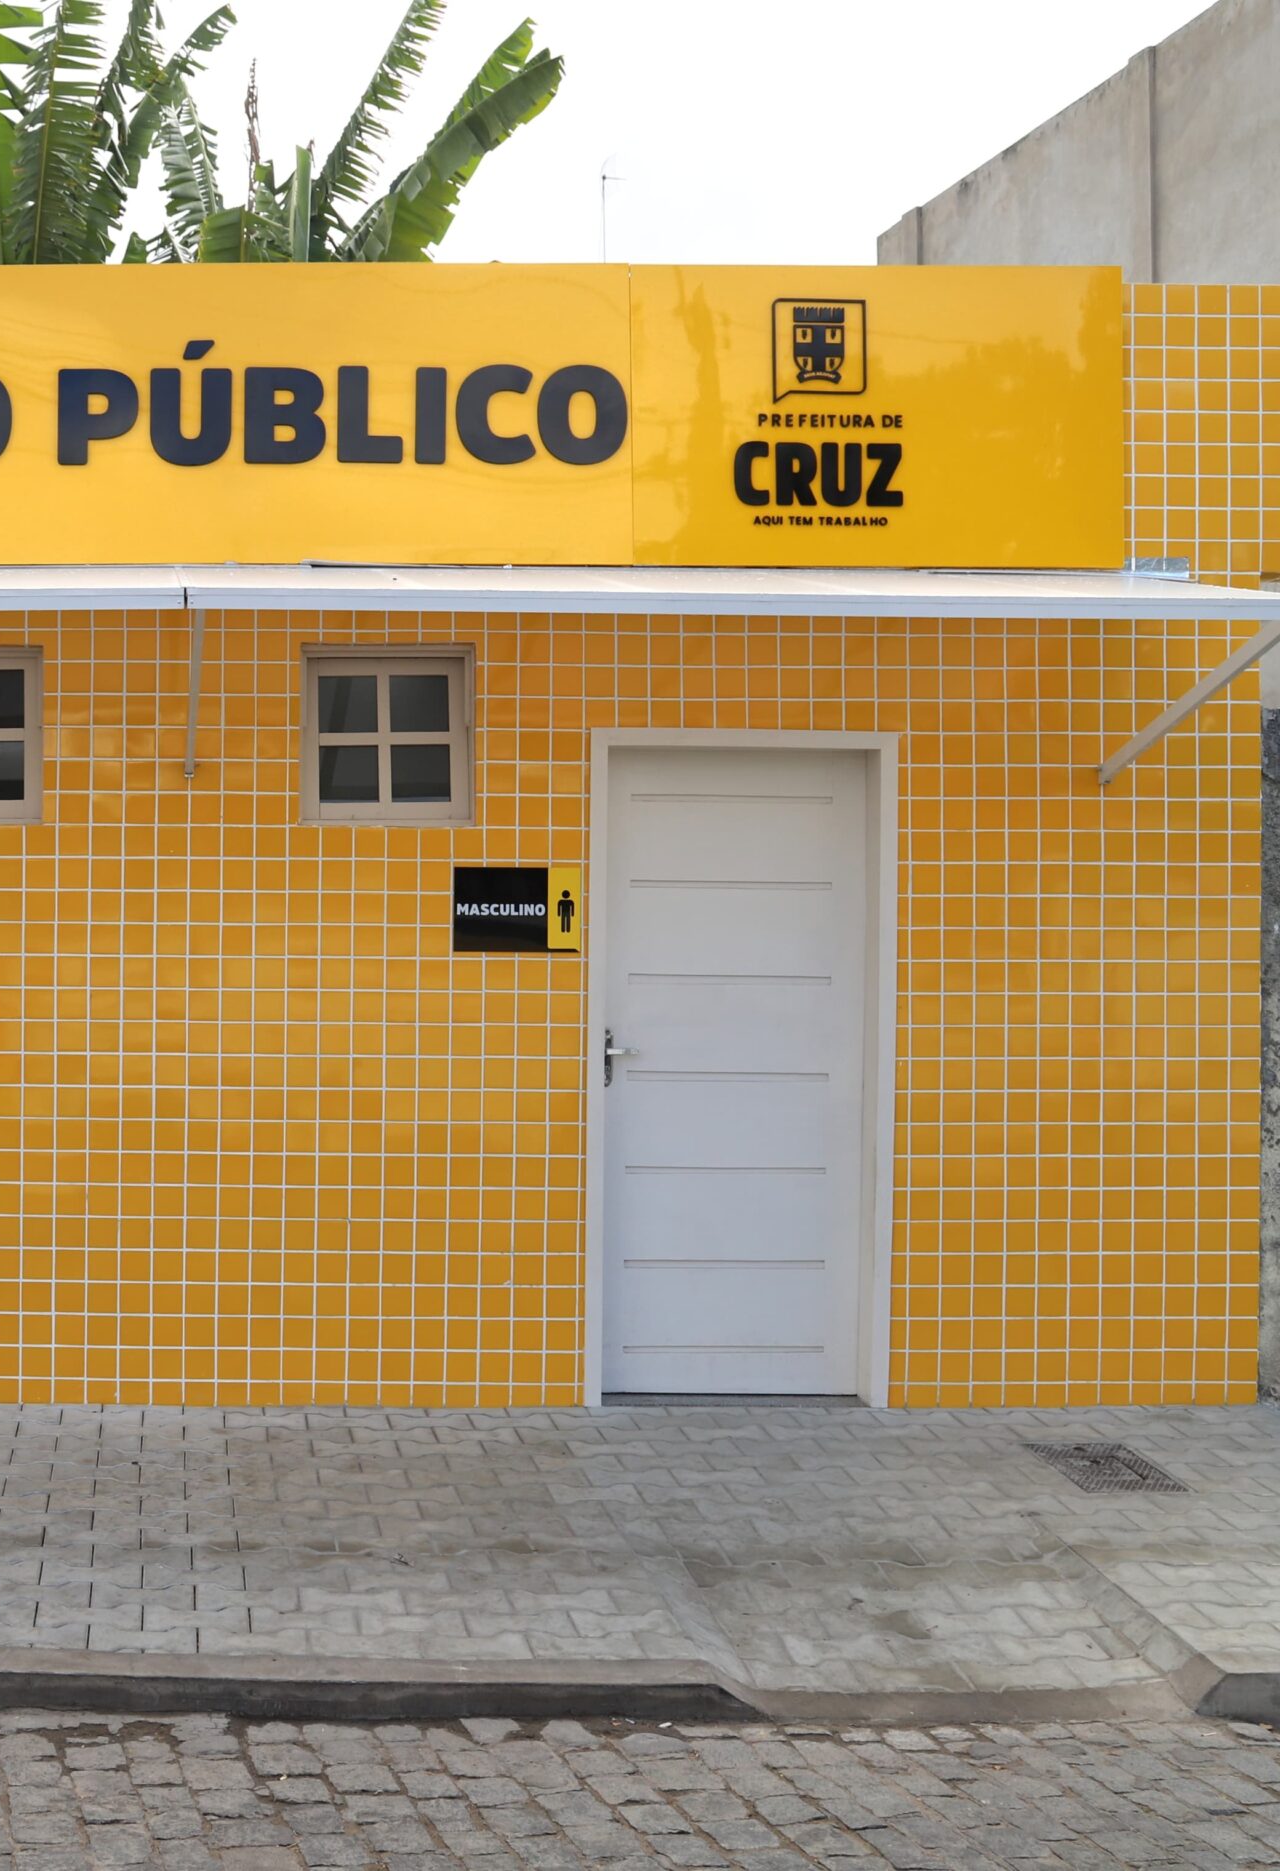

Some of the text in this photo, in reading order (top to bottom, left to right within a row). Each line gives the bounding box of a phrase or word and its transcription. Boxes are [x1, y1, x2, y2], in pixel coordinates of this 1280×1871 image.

[57, 340, 628, 467] PÚBLICO
[758, 413, 903, 429] PREFEITURA DE
[733, 440, 904, 508] CRUZ
[753, 515, 888, 527] AQUI TEM TRABALHO
[456, 903, 546, 917] MASCULINO
